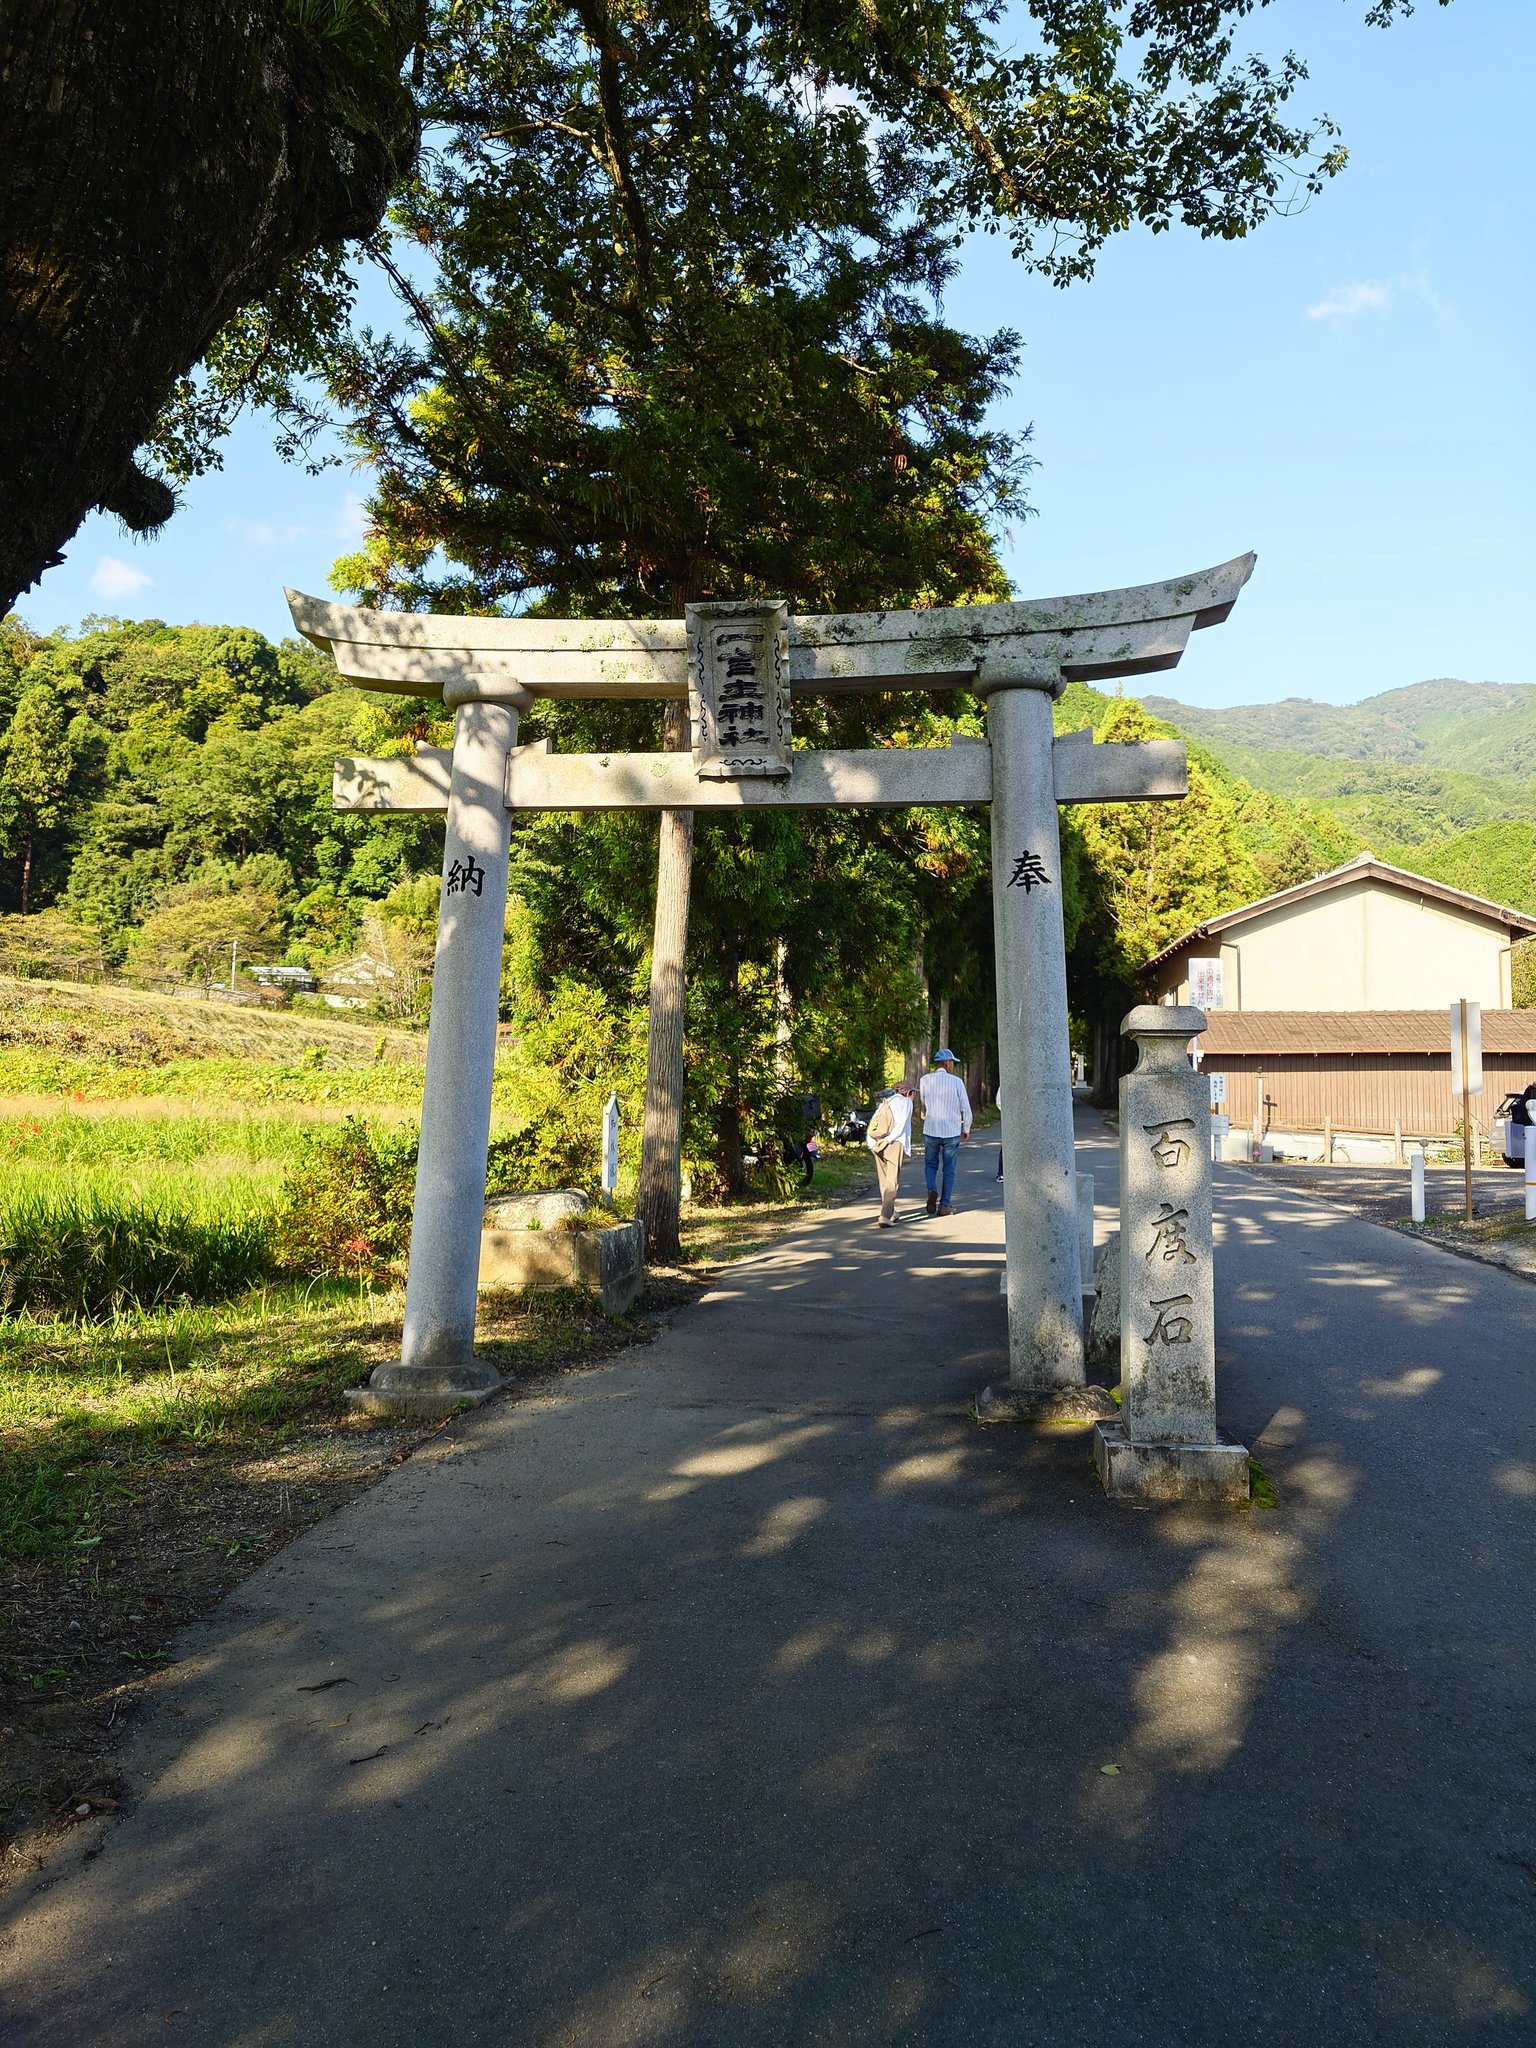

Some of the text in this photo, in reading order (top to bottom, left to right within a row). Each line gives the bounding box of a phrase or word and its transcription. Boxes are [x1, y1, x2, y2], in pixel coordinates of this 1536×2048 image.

[717, 634, 769, 747] 一言主神社
[447, 855, 486, 898] 納
[1006, 849, 1053, 896] 奉
[1143, 1118, 1198, 1348] 百度石
